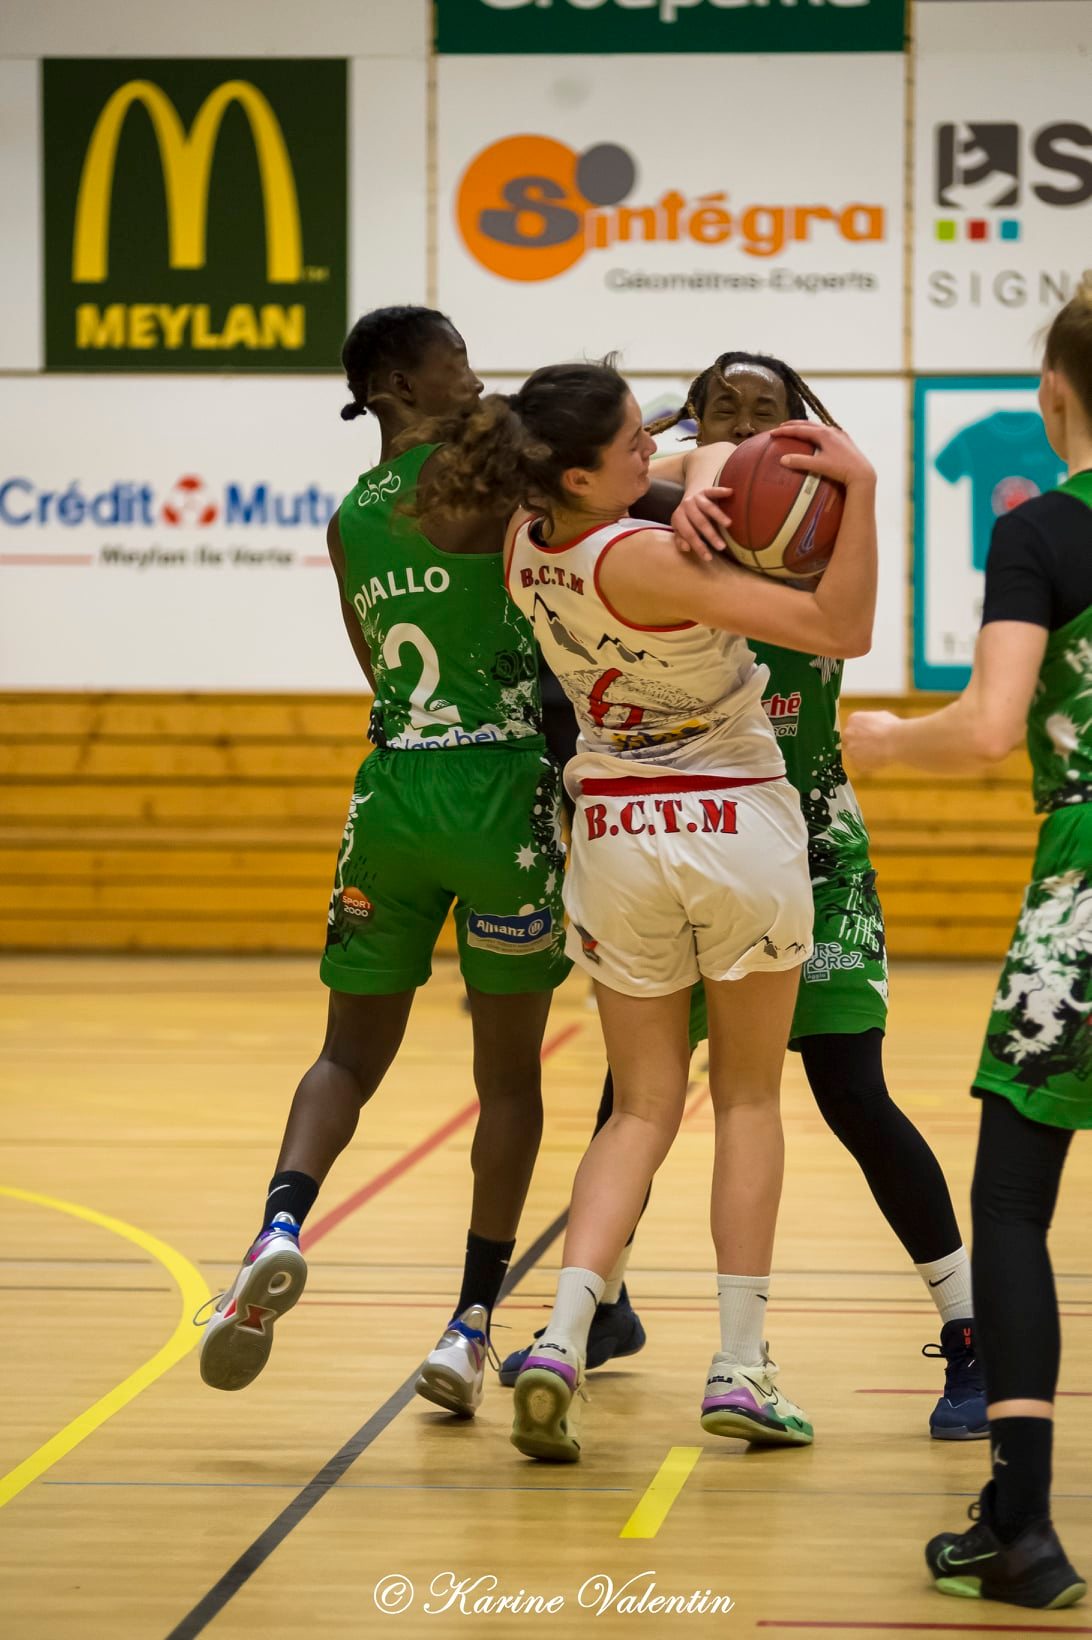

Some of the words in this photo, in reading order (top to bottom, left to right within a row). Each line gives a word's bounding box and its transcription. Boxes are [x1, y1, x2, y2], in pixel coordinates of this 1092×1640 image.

[479, 174, 887, 259] Sintégra
[76, 304, 305, 349] MEYLAN
[0, 476, 155, 527] Crédit
[353, 565, 451, 621] DIALLO
[520, 565, 584, 596] B.C.T.M
[382, 622, 463, 730] 2
[584, 799, 738, 841] B.C.T.M
[342, 895, 371, 909] SPORT
[343, 904, 369, 917] 2000
[476, 919, 527, 937] Allianz
